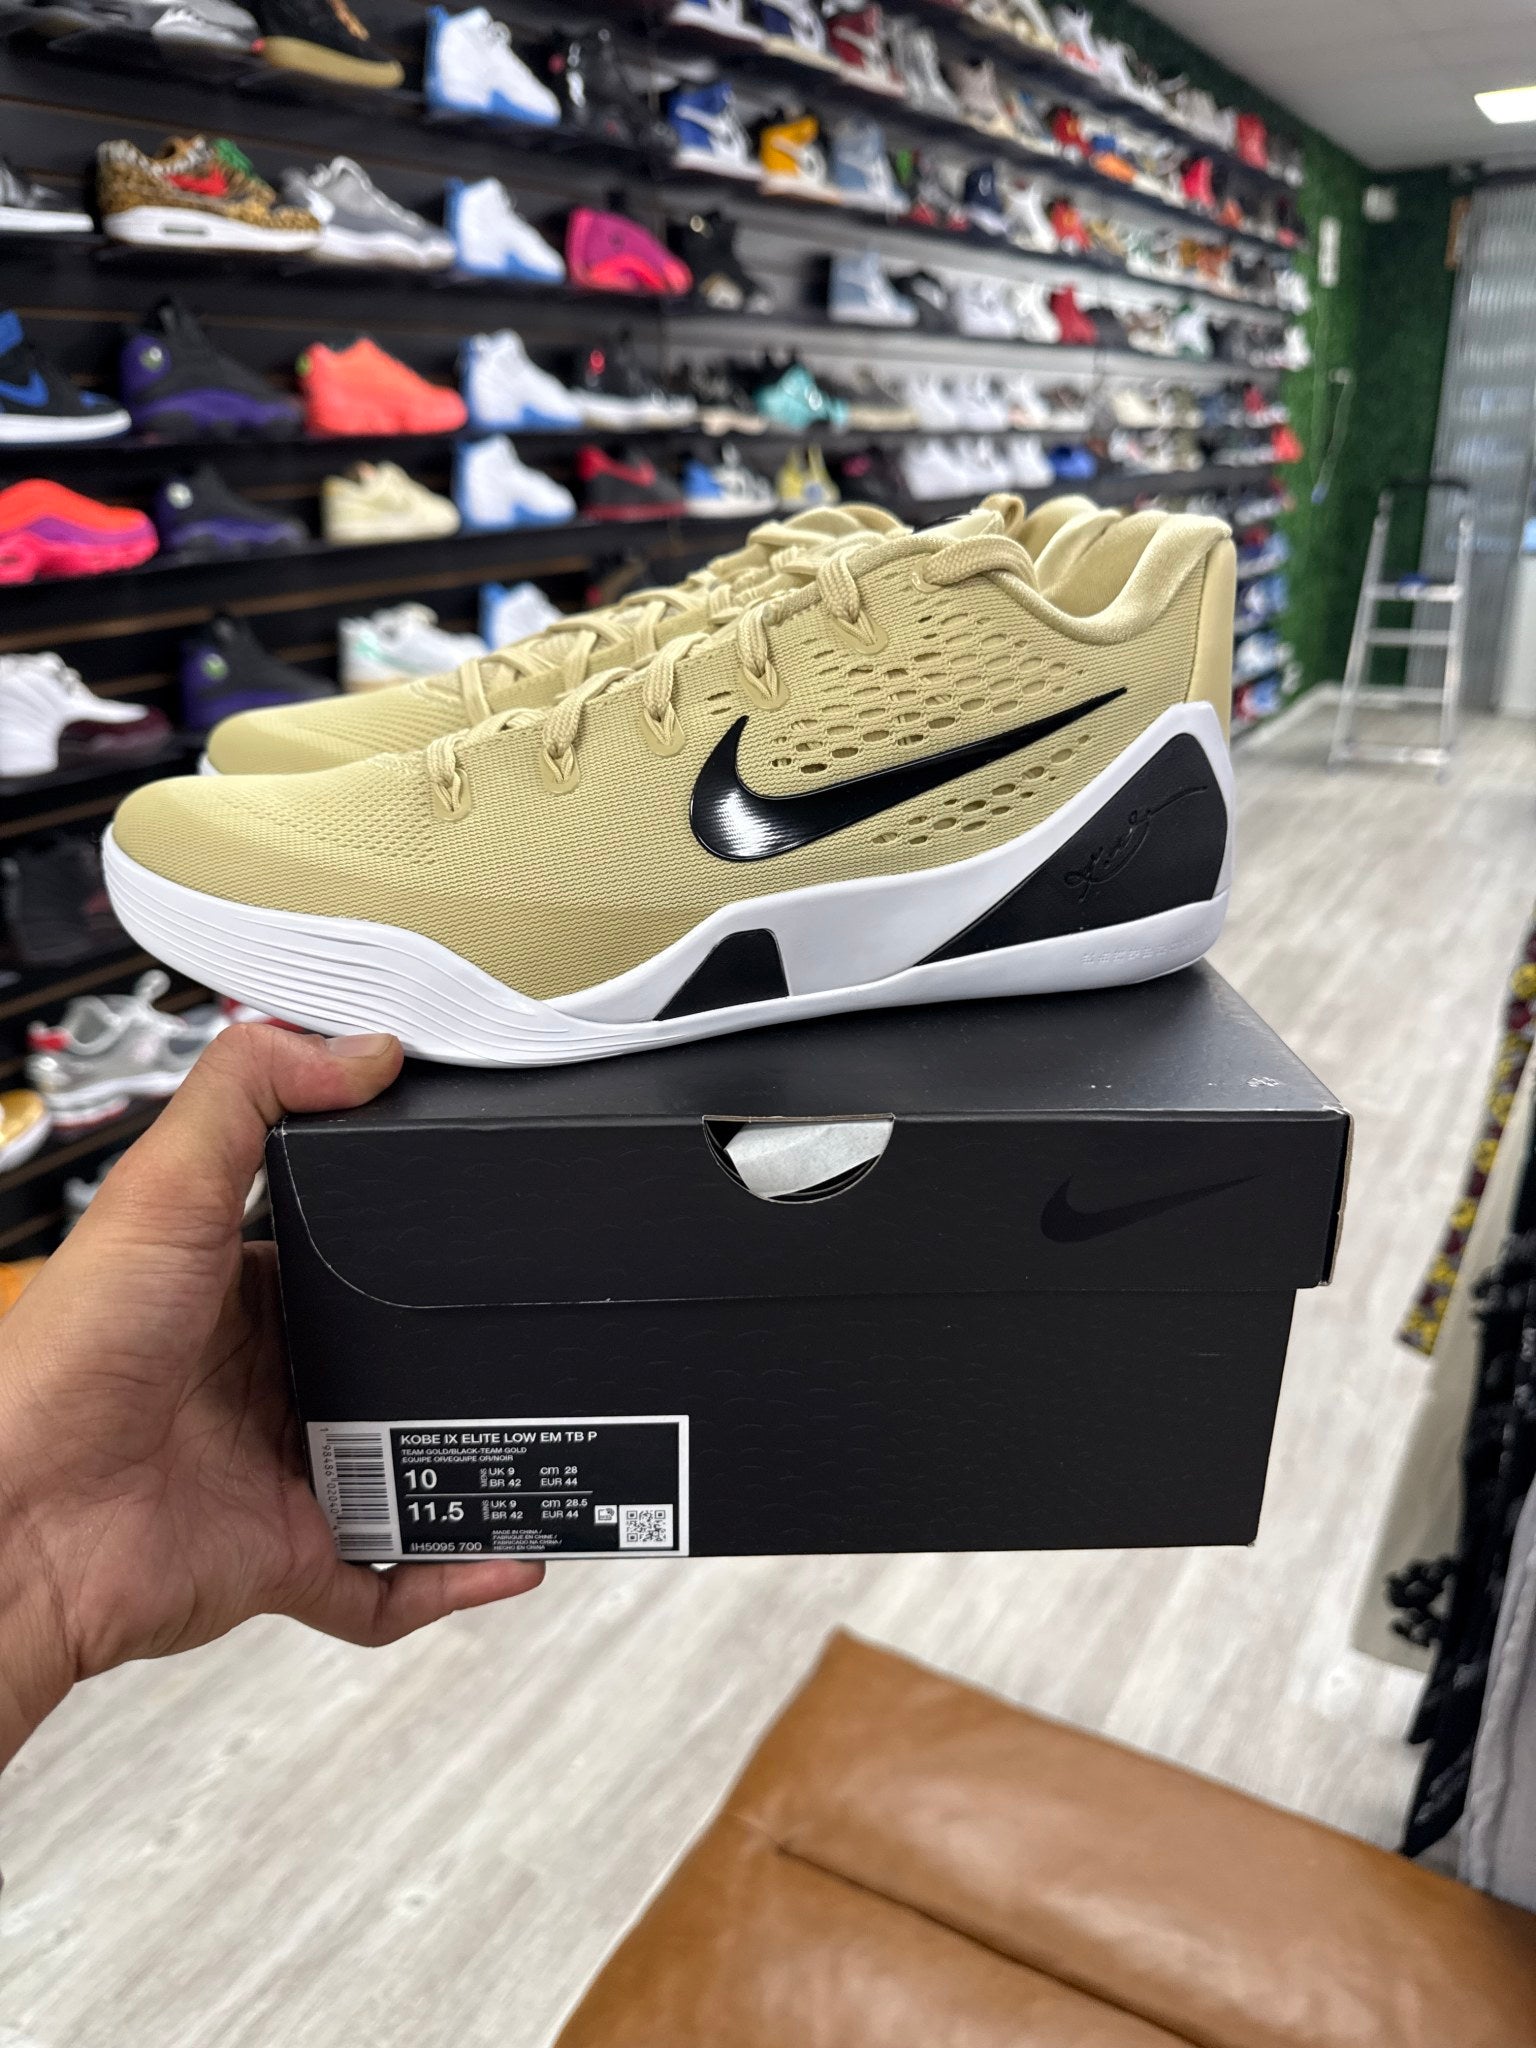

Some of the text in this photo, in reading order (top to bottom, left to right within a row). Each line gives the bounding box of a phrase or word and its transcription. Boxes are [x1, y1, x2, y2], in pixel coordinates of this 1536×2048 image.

[400, 1430, 598, 1445] KOBE IX ELITE LOW EM TB P
[425, 1447, 503, 1455] GOLD/BLACK-TEAM
[488, 1466, 515, 1476] UK 9
[540, 1465, 578, 1475] cm 28
[404, 1468, 438, 1489] 10
[489, 1478, 522, 1487] BR 42
[541, 1477, 578, 1487] EUR 44
[491, 1499, 517, 1508] UK 9
[541, 1498, 588, 1508] cm 28.5
[406, 1501, 465, 1522] 11.5
[491, 1510, 524, 1520] BR 42
[542, 1509, 579, 1519] EUR 44
[410, 1541, 483, 1552] IH5095 700
